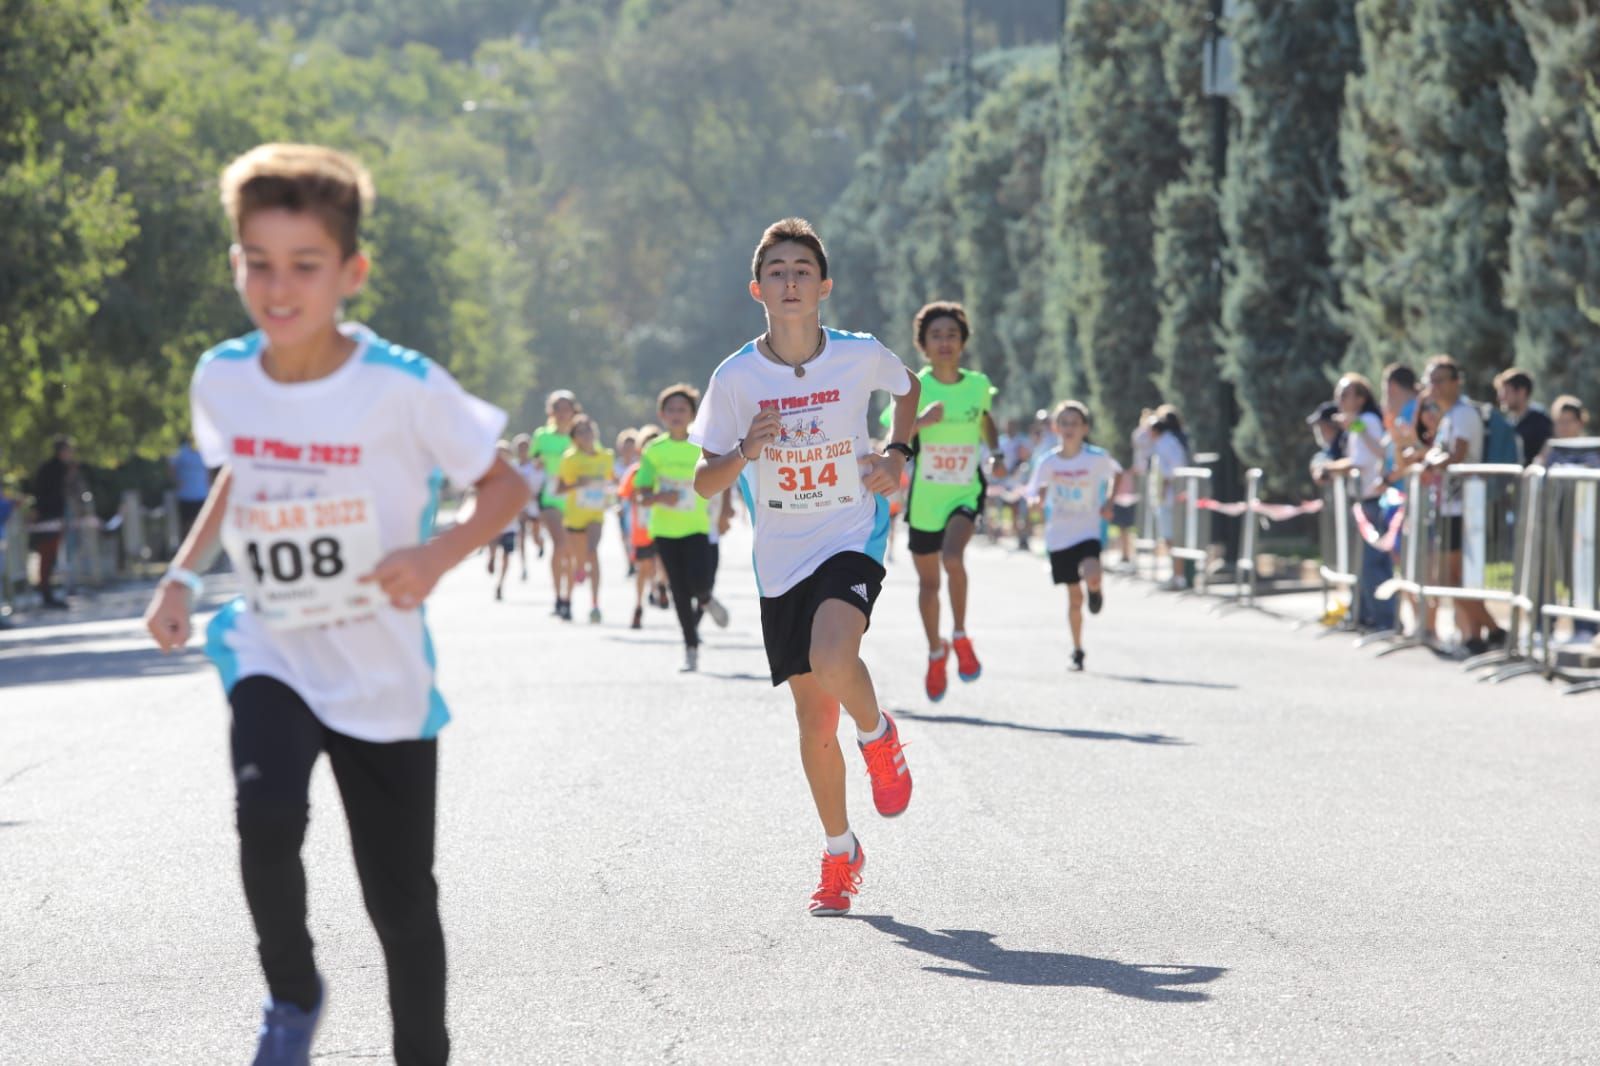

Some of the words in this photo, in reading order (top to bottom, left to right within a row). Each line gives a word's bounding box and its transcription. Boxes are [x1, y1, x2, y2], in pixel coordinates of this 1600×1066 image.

[781, 396, 809, 409] Pilar
[811, 389, 840, 405] 2022
[310, 443, 361, 464] 2022
[764, 446, 783, 463] 10K
[786, 447, 823, 463] PILAR
[826, 440, 852, 459] 2022
[932, 455, 968, 471] 307
[777, 462, 838, 492] 314
[795, 491, 823, 500] LUCAS
